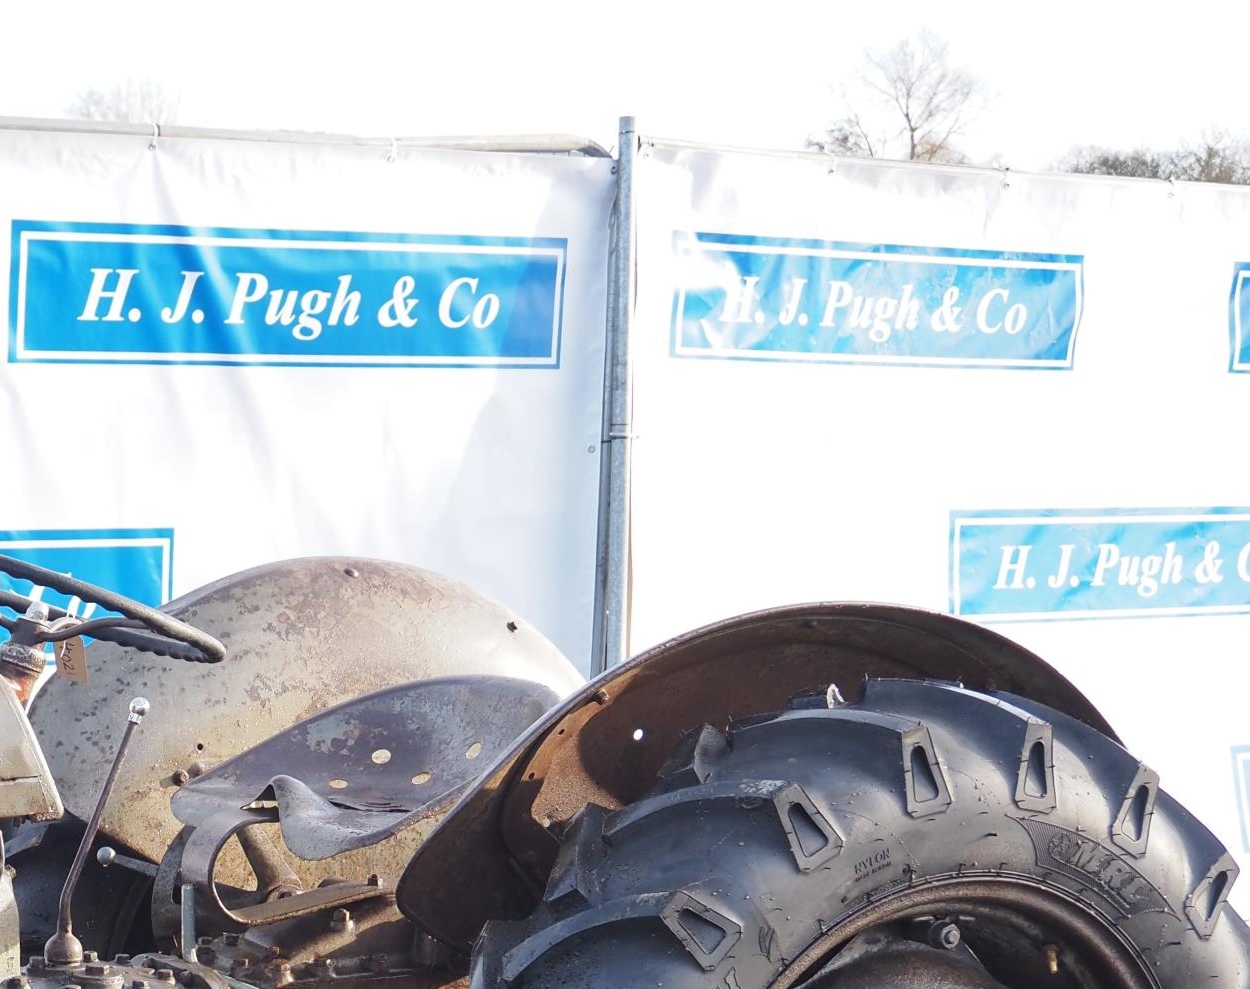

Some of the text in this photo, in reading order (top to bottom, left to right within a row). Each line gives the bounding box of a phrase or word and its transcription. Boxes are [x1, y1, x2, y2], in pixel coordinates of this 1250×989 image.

[77, 268, 500, 341] H. J. Pugh & Co
[718, 275, 1027, 342] H. J. Pugh & Co
[993, 544, 1036, 589] H.
[1048, 544, 1080, 589] J.
[1090, 541, 1182, 597] Pugh
[1195, 540, 1224, 584] &
[854, 848, 890, 874] NYLON
[1068, 841, 1149, 905] MRL
